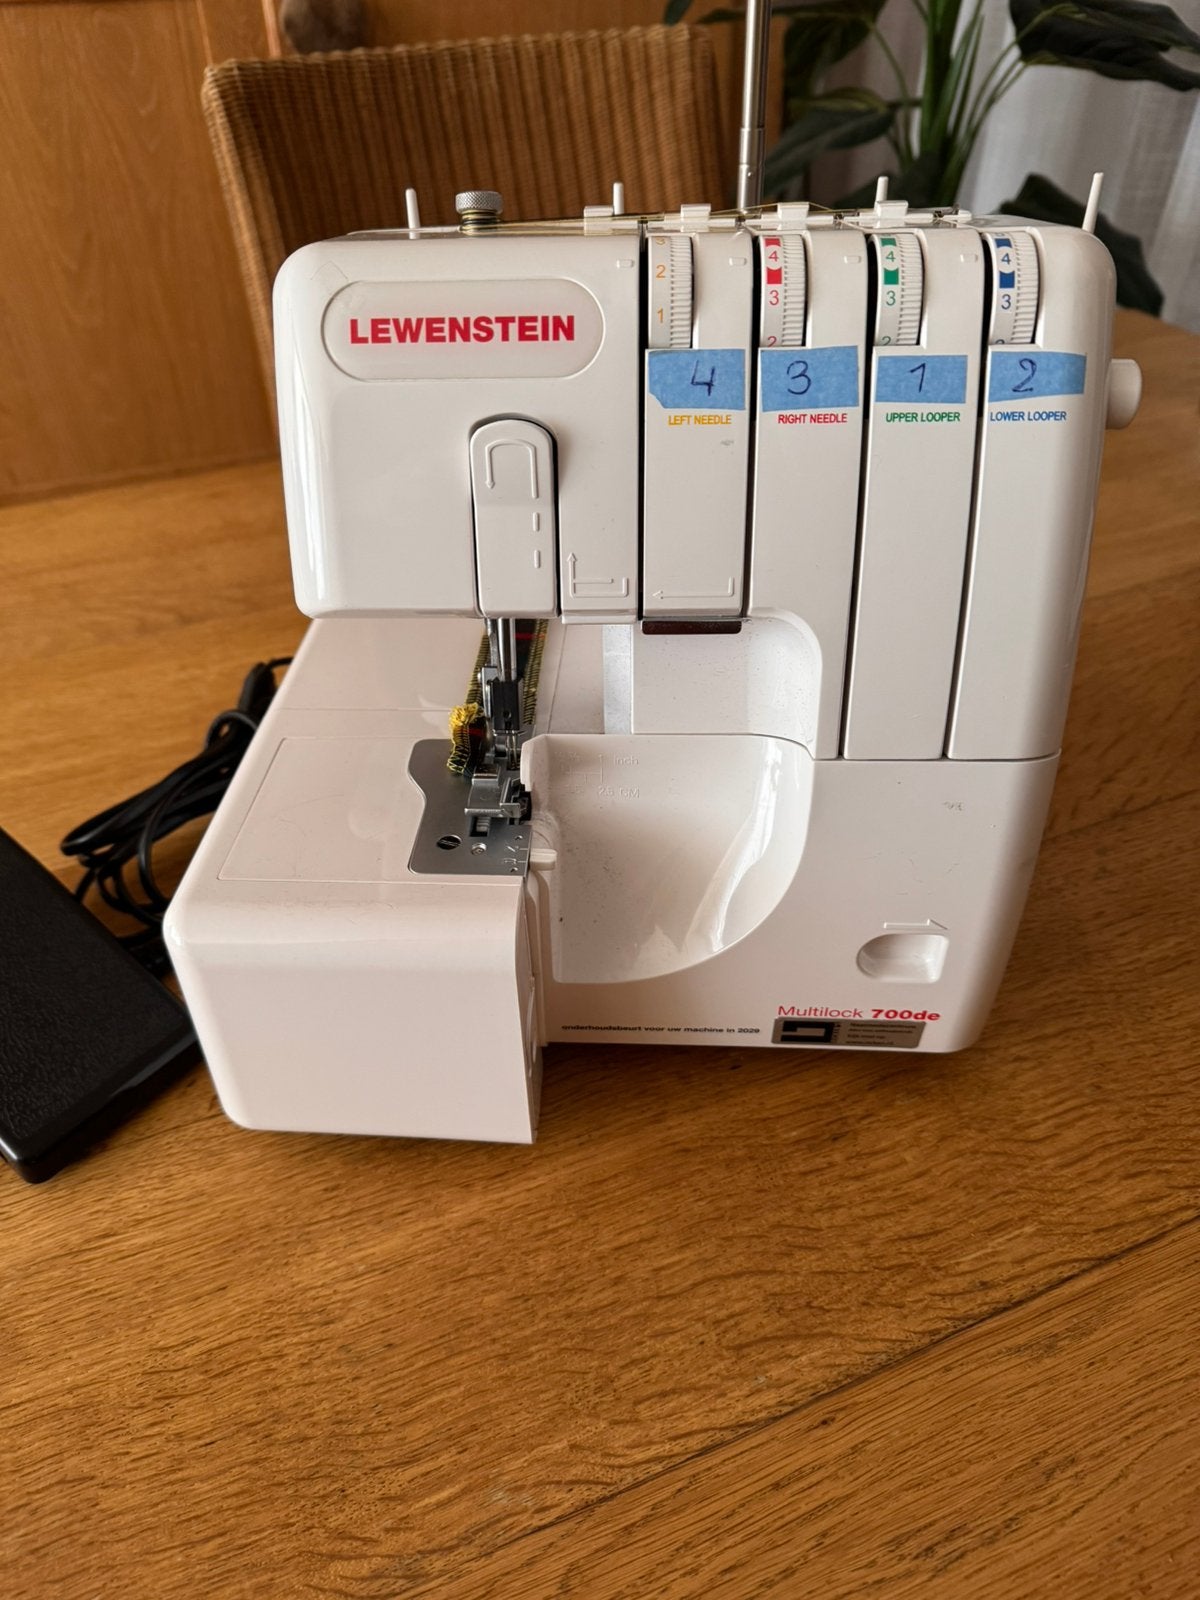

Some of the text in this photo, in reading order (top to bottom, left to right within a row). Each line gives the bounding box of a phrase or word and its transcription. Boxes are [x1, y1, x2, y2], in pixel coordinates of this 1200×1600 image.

[768, 250, 779, 262] 4
[885, 250, 896, 262] 4
[1001, 252, 1012, 265] 4
[655, 265, 666, 278] 2
[769, 289, 780, 306] 3
[886, 290, 896, 306] 3
[1001, 294, 1012, 310] 3
[657, 308, 665, 323] 1
[350, 315, 575, 344] LEWENSTEIN
[690, 359, 716, 397] 4
[786, 360, 812, 395] 3
[909, 362, 926, 393] 1
[1012, 358, 1037, 392] 2
[668, 414, 732, 426] LEFT NEEDLE
[778, 413, 848, 424] RIGHT NEEDLE
[885, 412, 961, 423] UPPER LOOPER
[990, 410, 1067, 422] LOWER LOOPER
[778, 1005, 941, 1021] Multilock 700de
